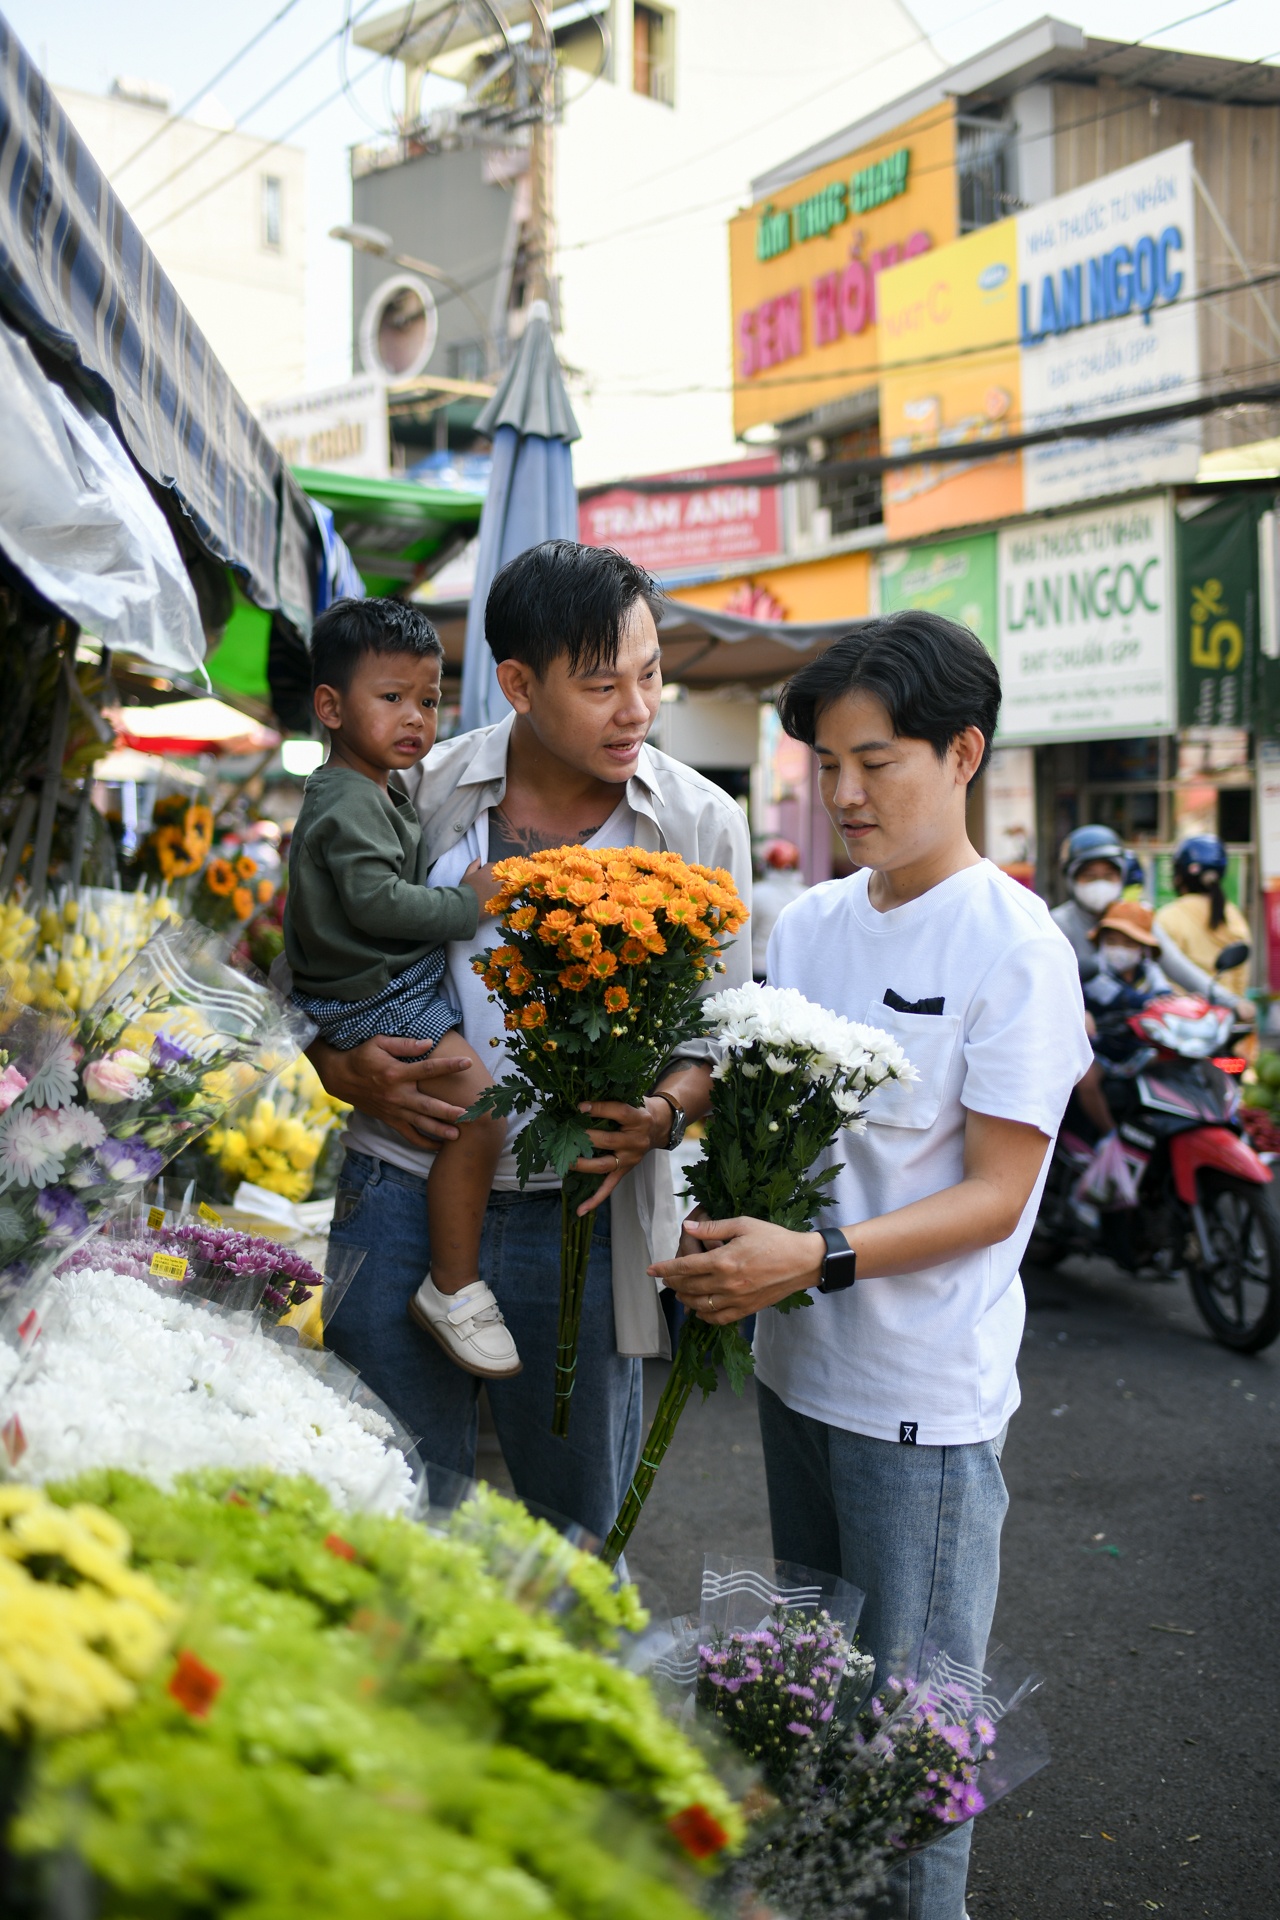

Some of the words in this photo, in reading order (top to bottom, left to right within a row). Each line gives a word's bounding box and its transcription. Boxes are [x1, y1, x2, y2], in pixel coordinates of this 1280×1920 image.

[851, 148, 911, 215] CHAY
[1020, 263, 1082, 348] LAN
[1087, 226, 1183, 326] NGỌC
[740, 287, 804, 378] SEN
[684, 487, 761, 526] ANH
[1006, 575, 1063, 632] LAN
[1067, 558, 1160, 634] NGỌC
[1190, 578, 1244, 672] 5%
[164, 1057, 198, 1086] Đồng
